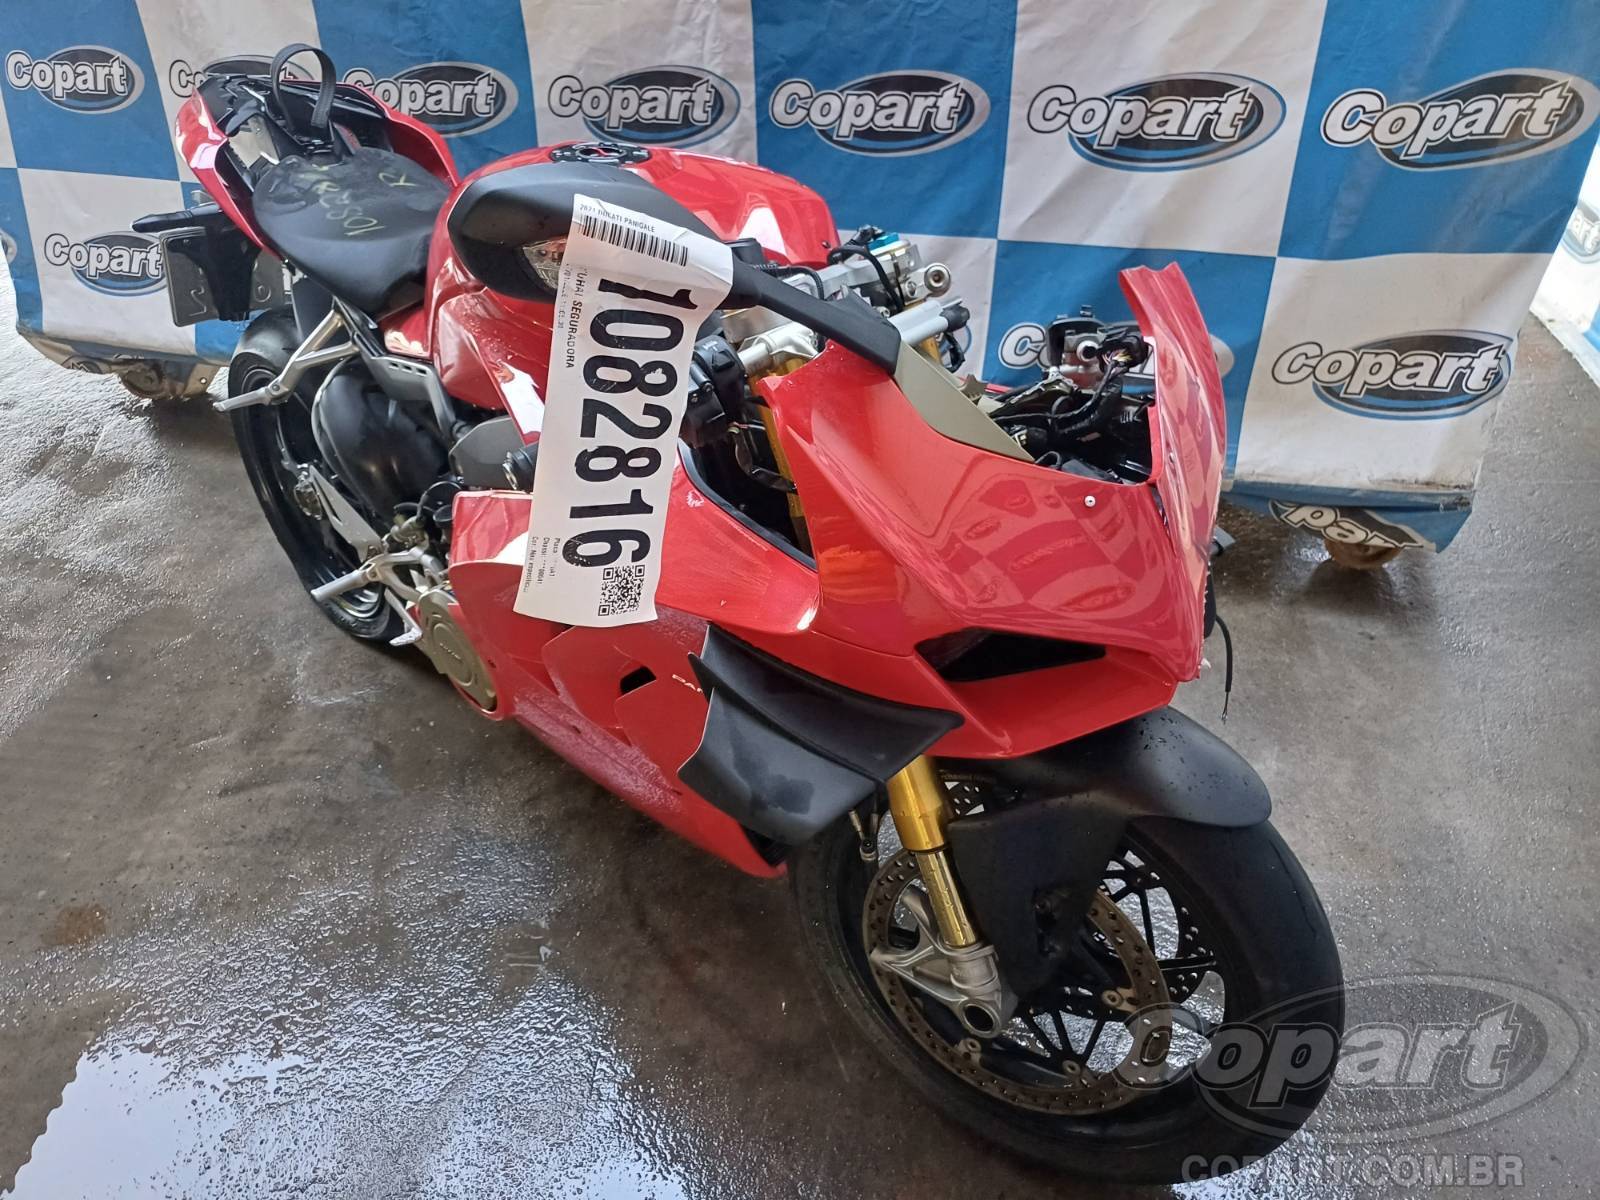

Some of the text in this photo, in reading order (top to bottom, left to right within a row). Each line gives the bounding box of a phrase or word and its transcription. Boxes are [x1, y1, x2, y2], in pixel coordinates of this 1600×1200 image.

[5, 50, 128, 98] Copart
[548, 75, 715, 131] Copart
[769, 80, 966, 137] Copart
[1027, 83, 1252, 148] Copart
[1321, 76, 1576, 160] Copart
[624, 216, 656, 233] PANIGALE
[44, 233, 162, 279] Copart
[565, 266, 588, 369] UHAI SEGURADORA
[1272, 338, 1509, 398] Copart
[562, 278, 698, 568] 1082816
